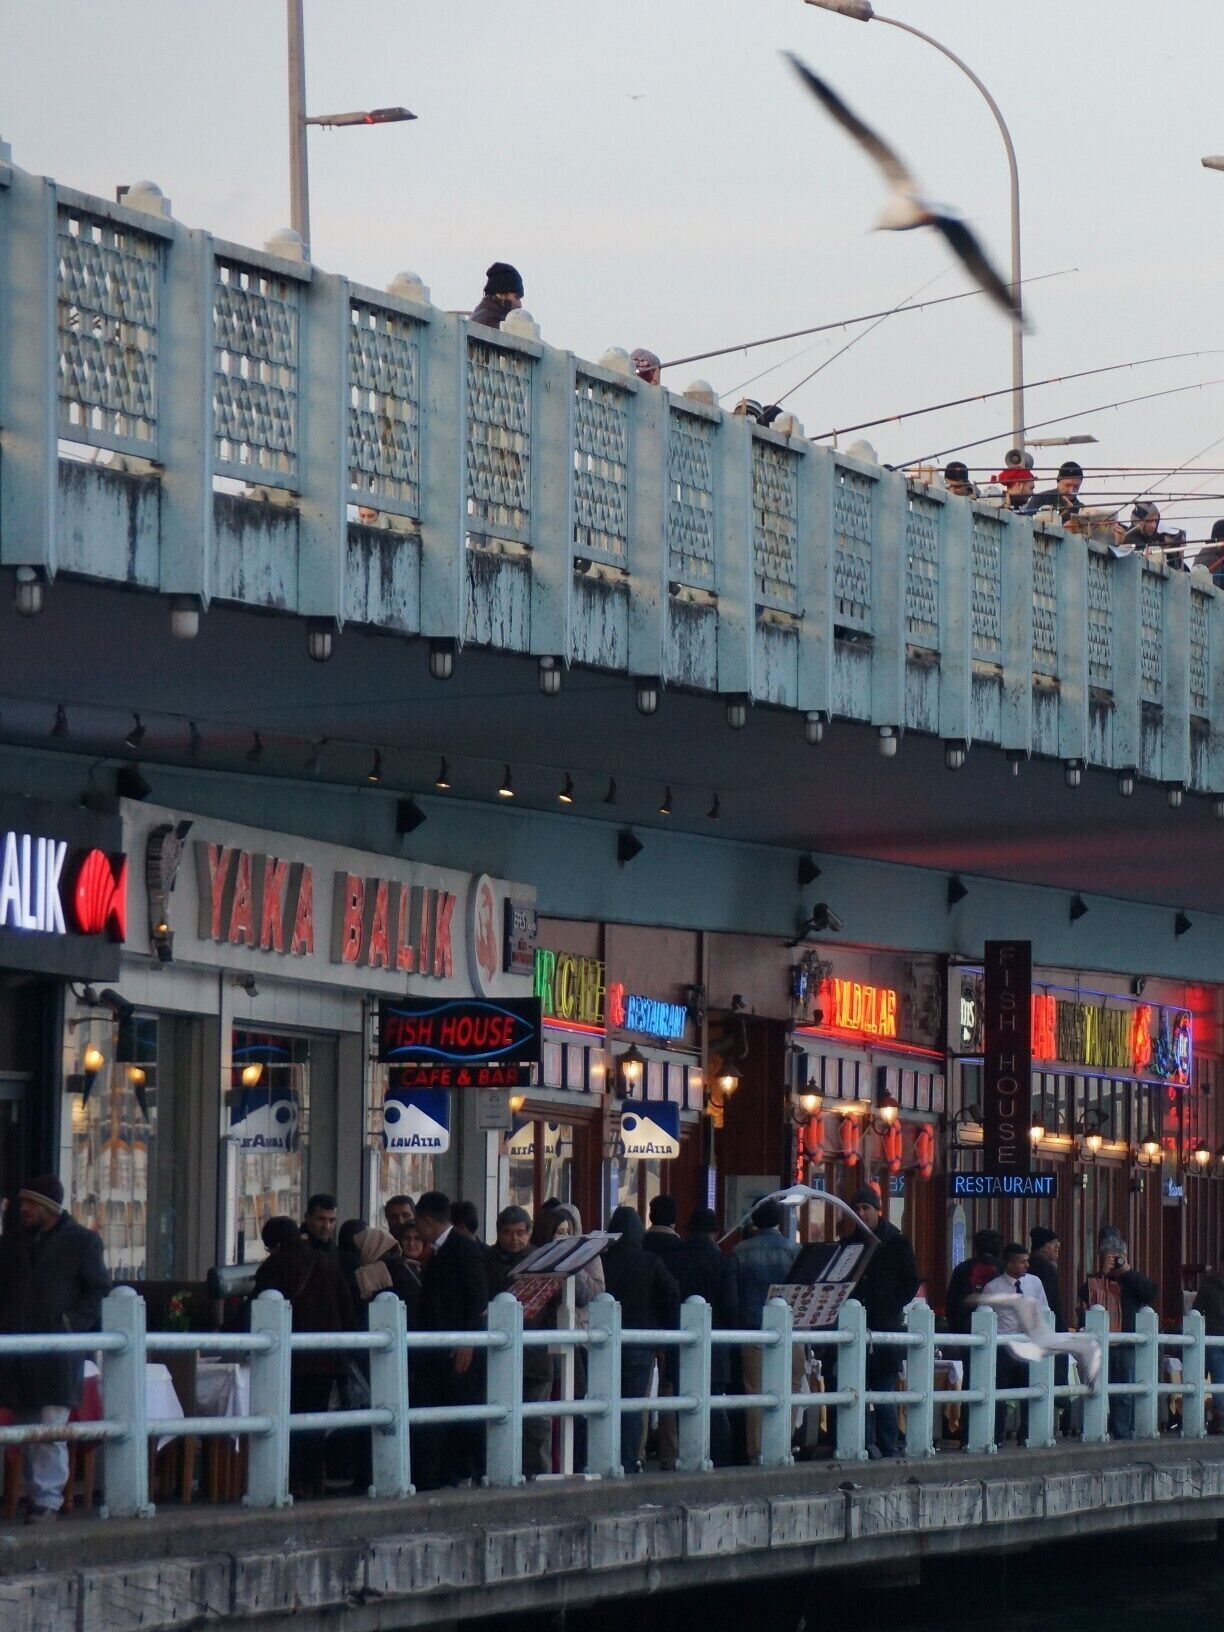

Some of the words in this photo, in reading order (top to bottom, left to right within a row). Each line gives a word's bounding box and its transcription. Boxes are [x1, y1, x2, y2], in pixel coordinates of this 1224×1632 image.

[206, 842, 315, 956] YAKA
[341, 872, 457, 978] BALIK
[440, 1014, 516, 1047] HOUSE
[478, 1067, 518, 1086] BAR
[390, 1133, 442, 1148] LAVAZZA
[627, 1142, 673, 1154] LAVAZZA
[955, 1176, 1054, 1195] RESTAURANT
